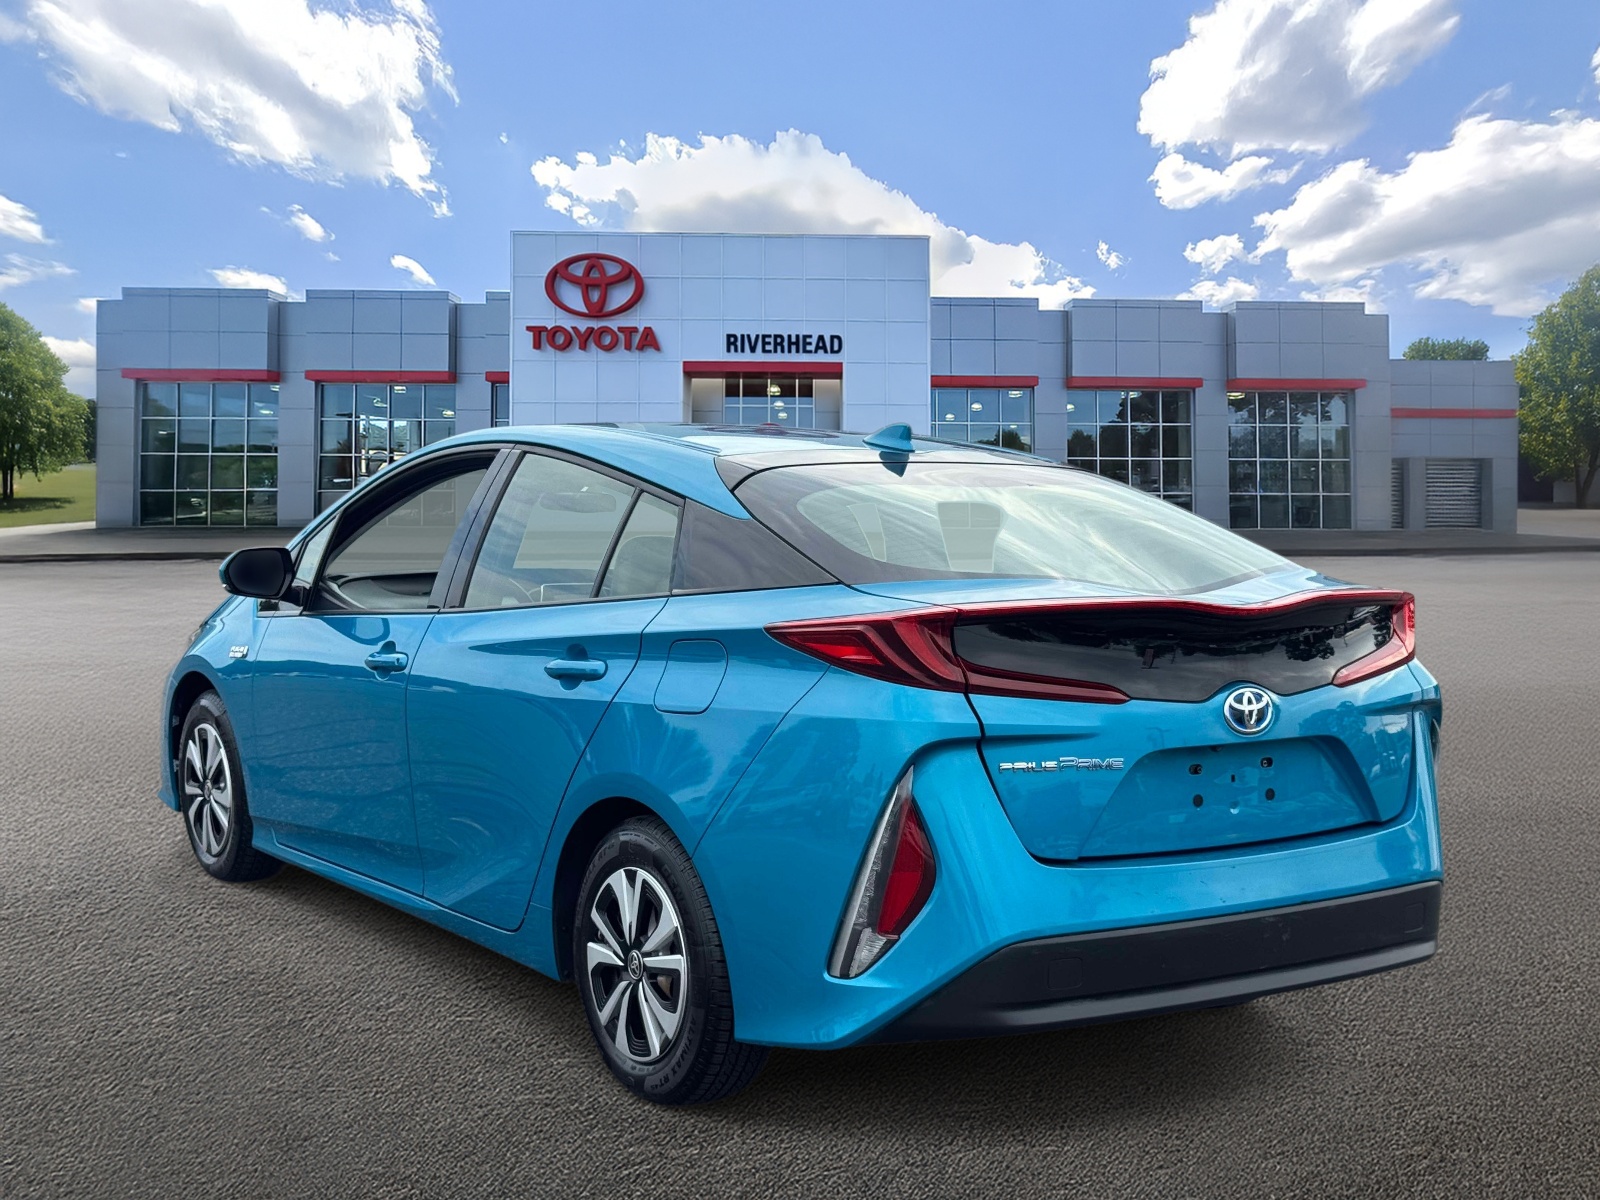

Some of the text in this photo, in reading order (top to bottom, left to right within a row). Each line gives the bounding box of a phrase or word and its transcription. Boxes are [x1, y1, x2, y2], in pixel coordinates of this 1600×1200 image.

[525, 325, 661, 351] TOYOTA
[726, 333, 843, 354] RIVERHEAD
[1059, 756, 1124, 771] PRIME
